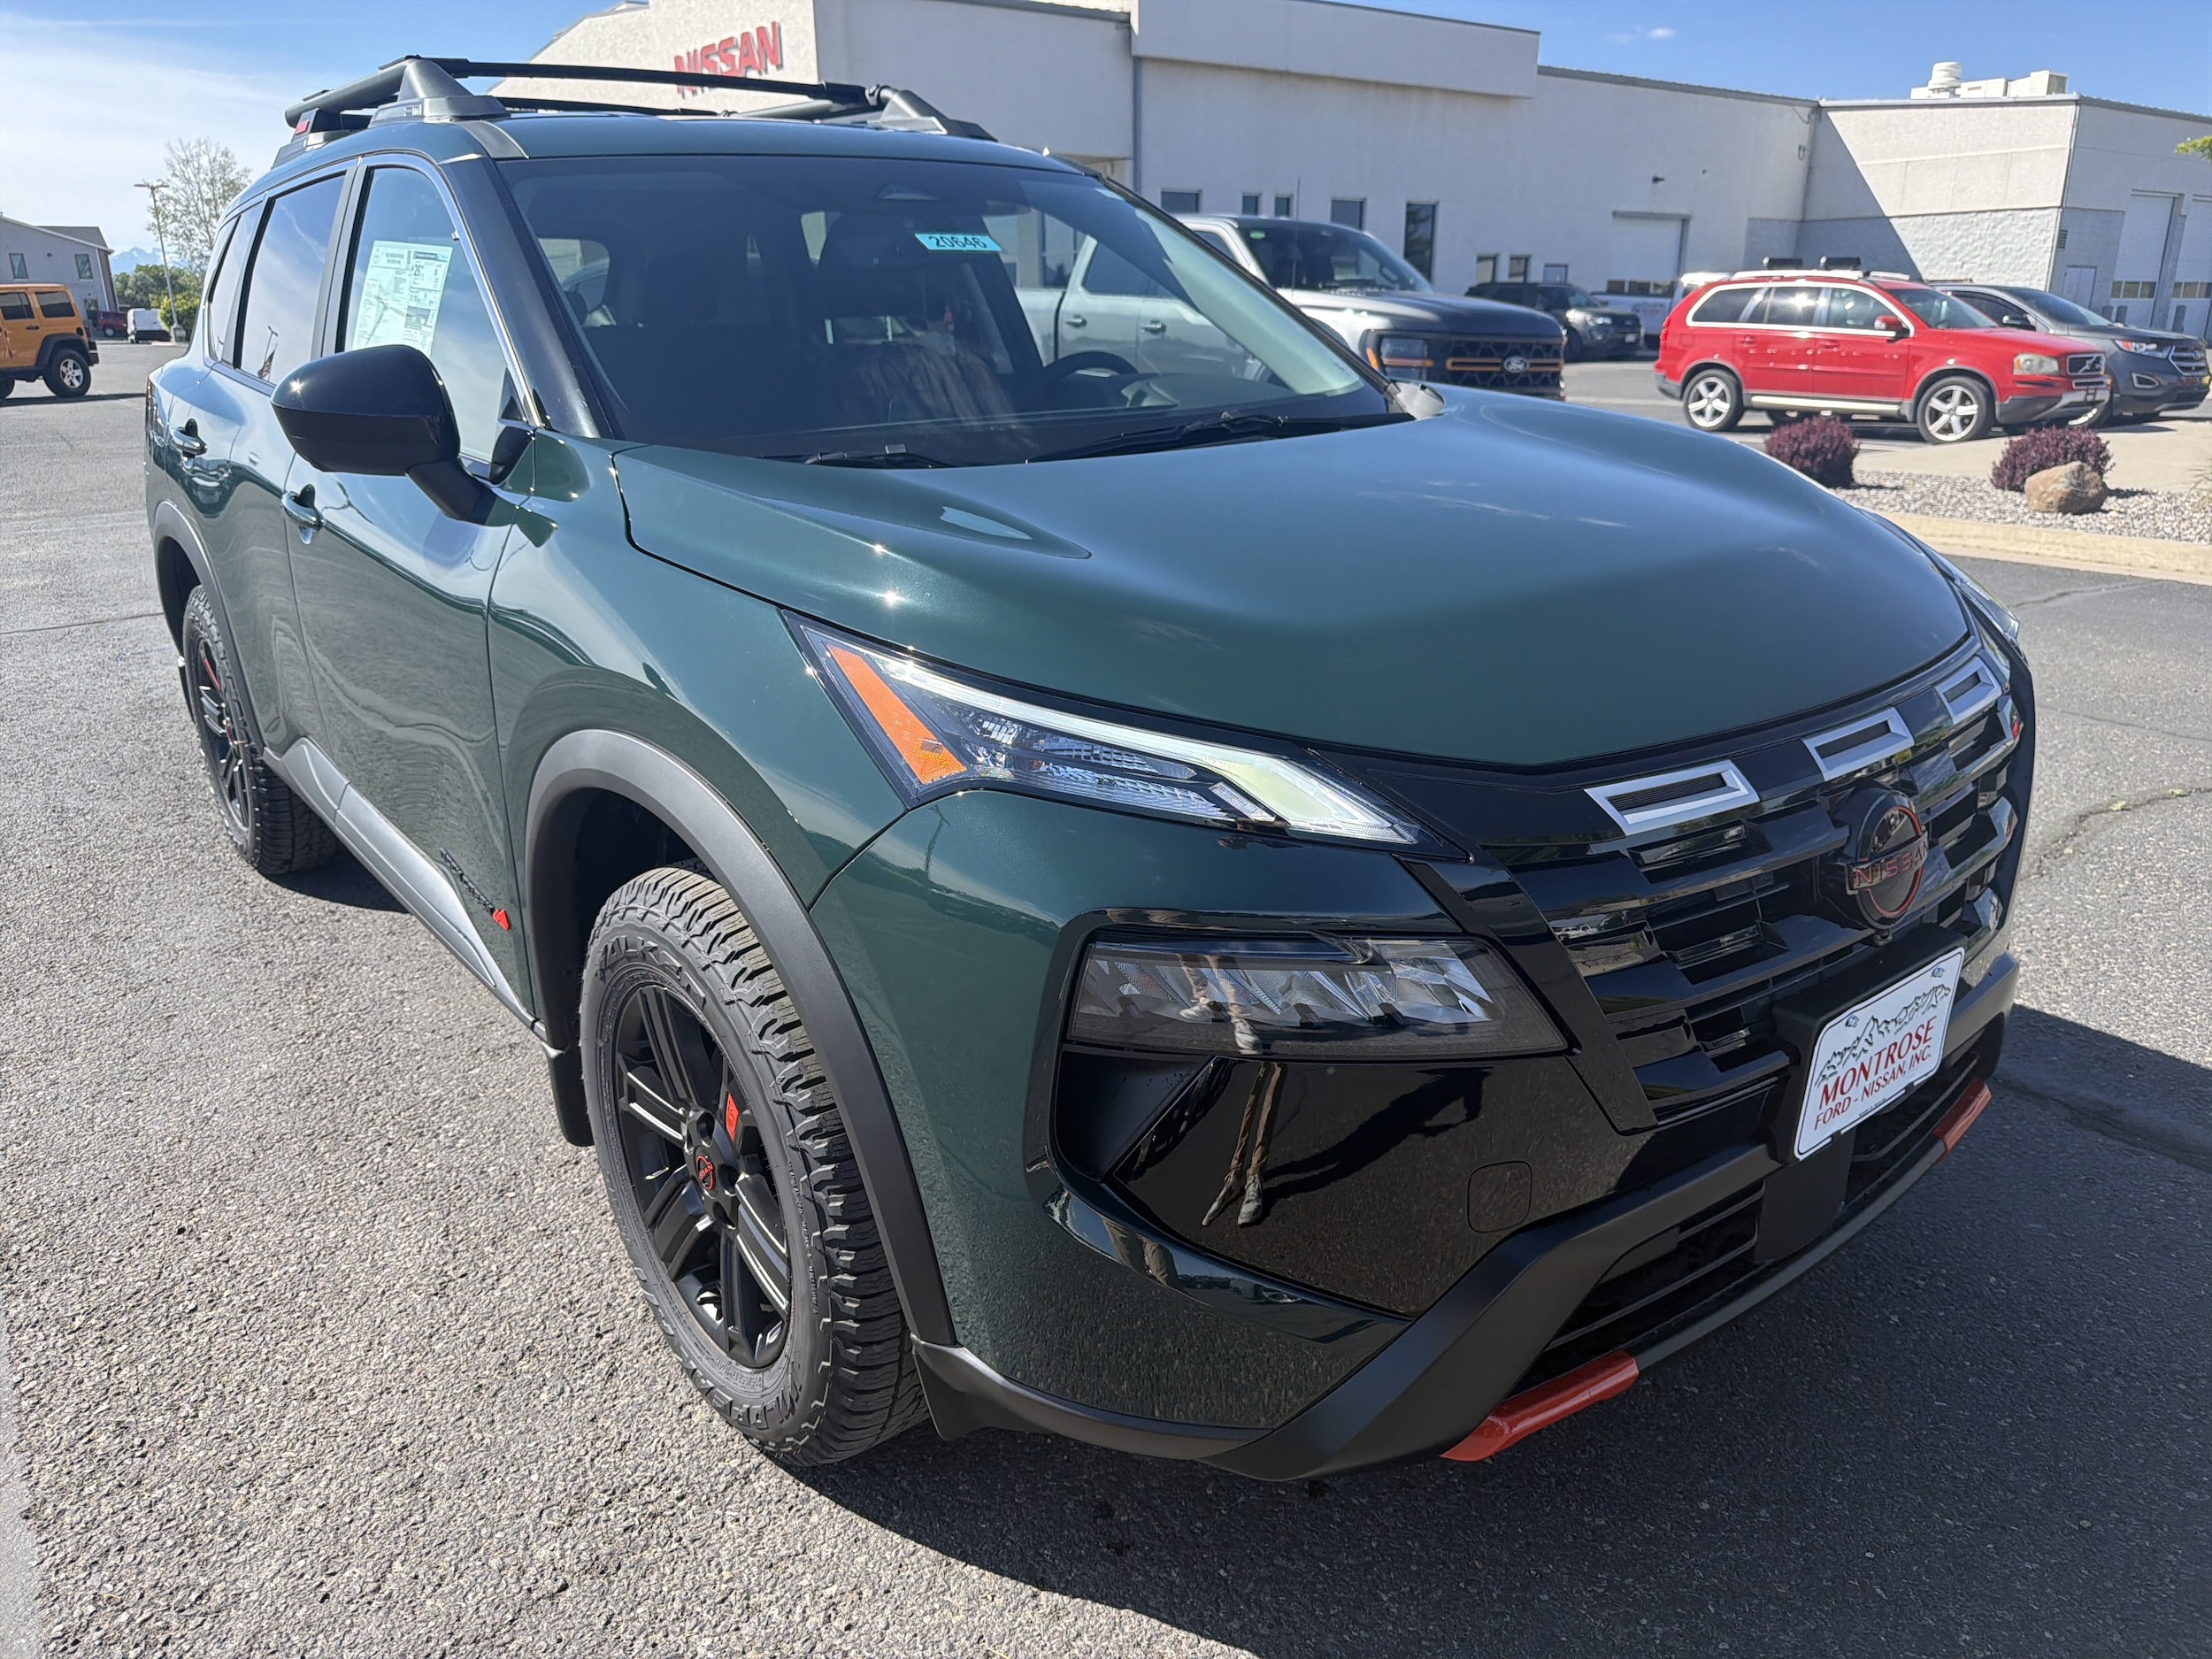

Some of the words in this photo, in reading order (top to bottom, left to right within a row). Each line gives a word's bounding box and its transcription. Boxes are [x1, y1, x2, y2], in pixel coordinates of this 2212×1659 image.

[673, 21, 781, 95] NISSAN
[928, 235, 987, 249] 20646
[1855, 841, 1929, 887] NISSAN
[1815, 1097, 1851, 1131] FORD
[1861, 1061, 1906, 1102] NISSAN,
[1909, 1045, 1932, 1071] INC.
[1819, 1016, 1937, 1110] MONTROSE
